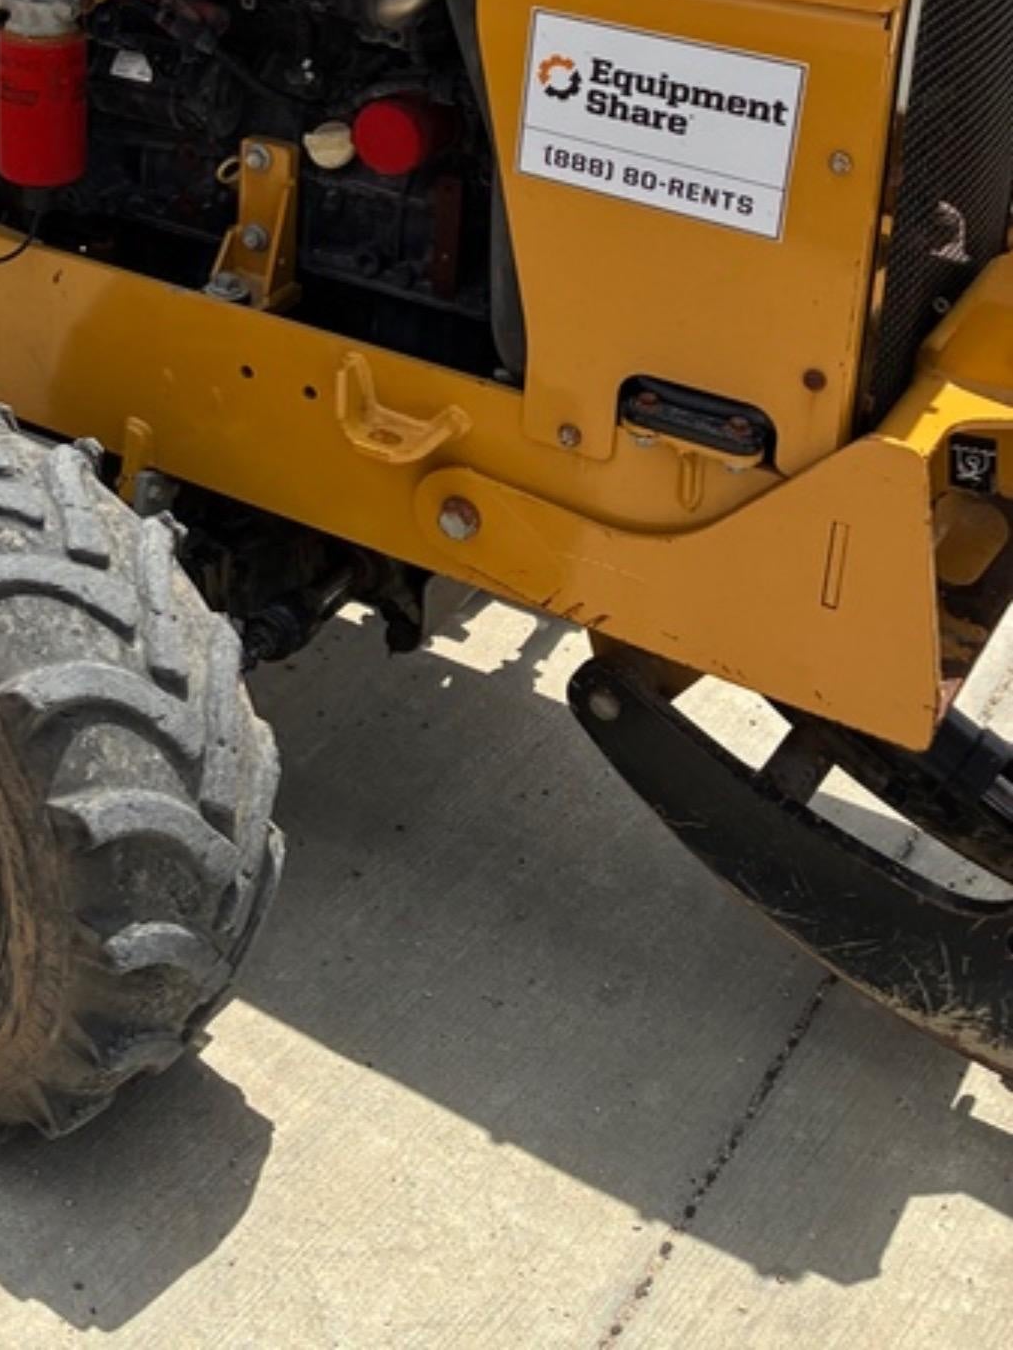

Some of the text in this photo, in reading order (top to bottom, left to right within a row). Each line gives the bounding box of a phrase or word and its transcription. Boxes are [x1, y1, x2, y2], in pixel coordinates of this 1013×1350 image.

[585, 92, 688, 136] Share
[589, 57, 789, 127] Equipment
[543, 144, 755, 216] (888) 80-RENTS
